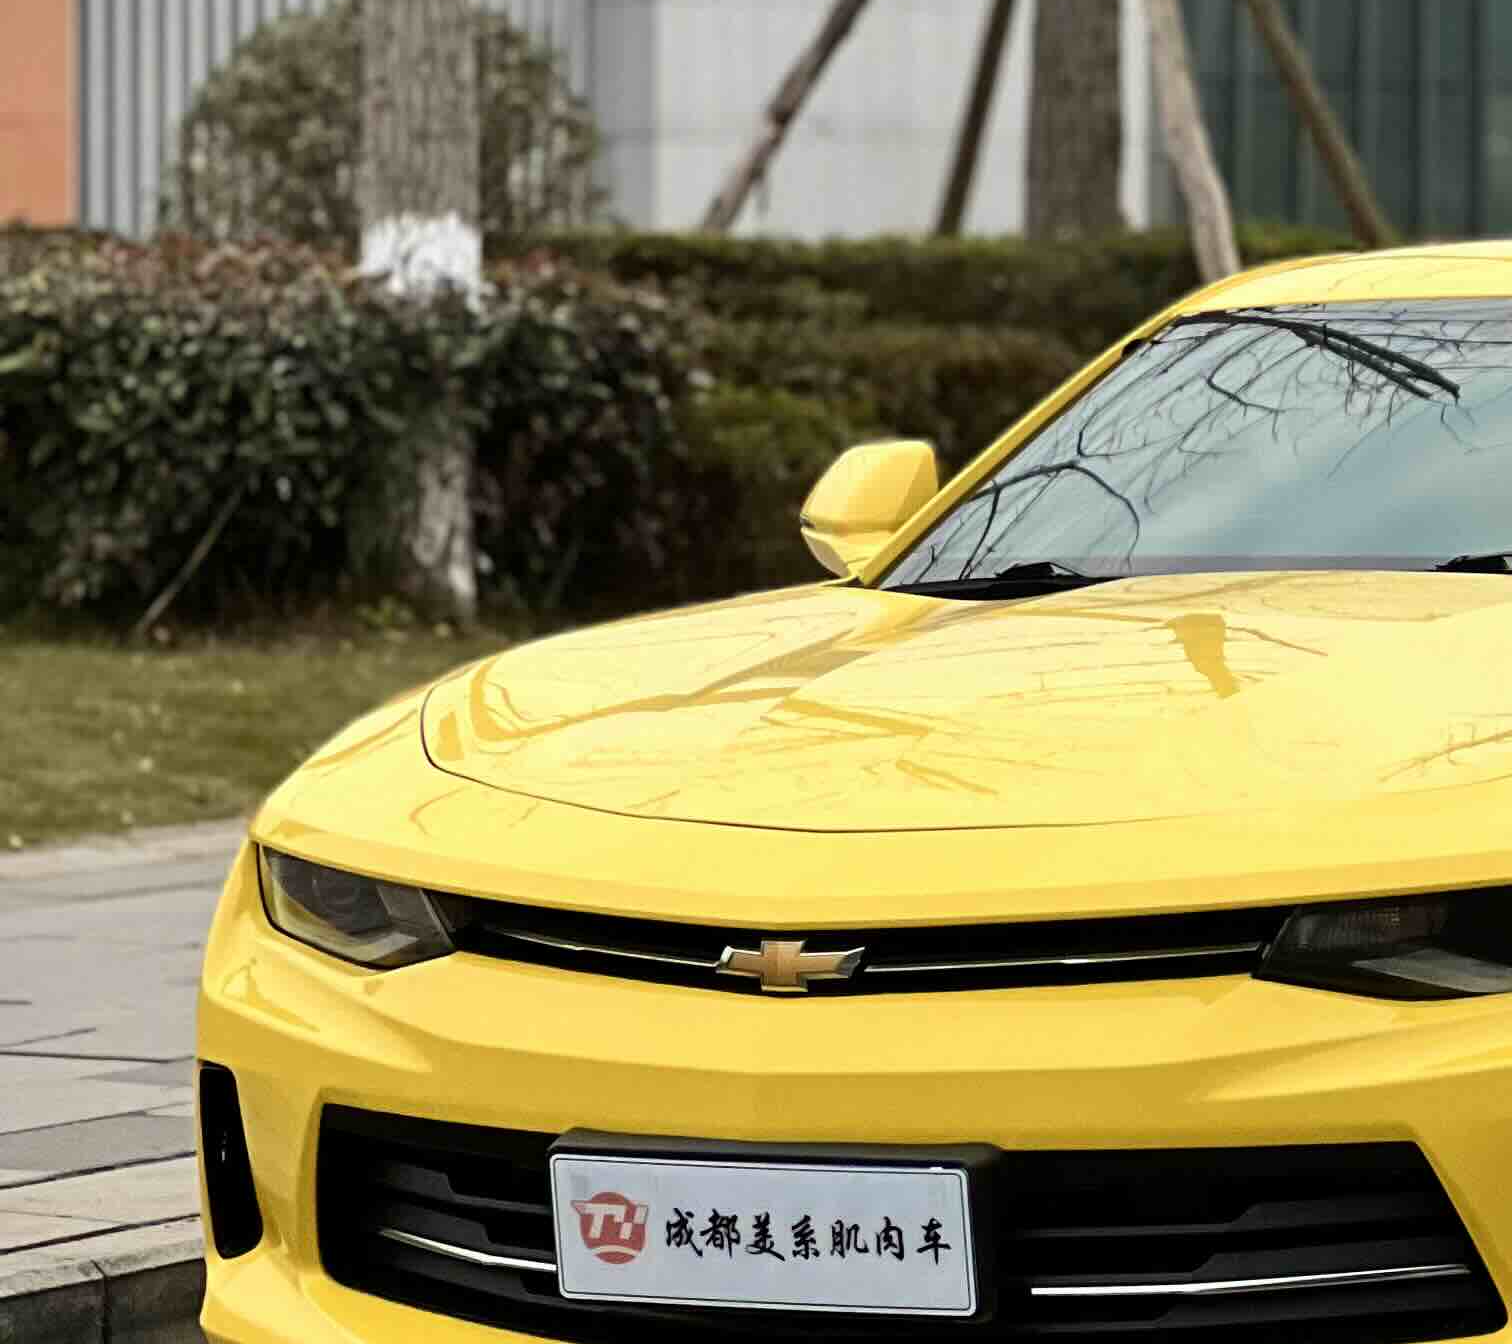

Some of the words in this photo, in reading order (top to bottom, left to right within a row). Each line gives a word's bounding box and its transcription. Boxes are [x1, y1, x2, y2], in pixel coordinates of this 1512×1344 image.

[665, 1207, 952, 1264] 成都美系肌肉车
